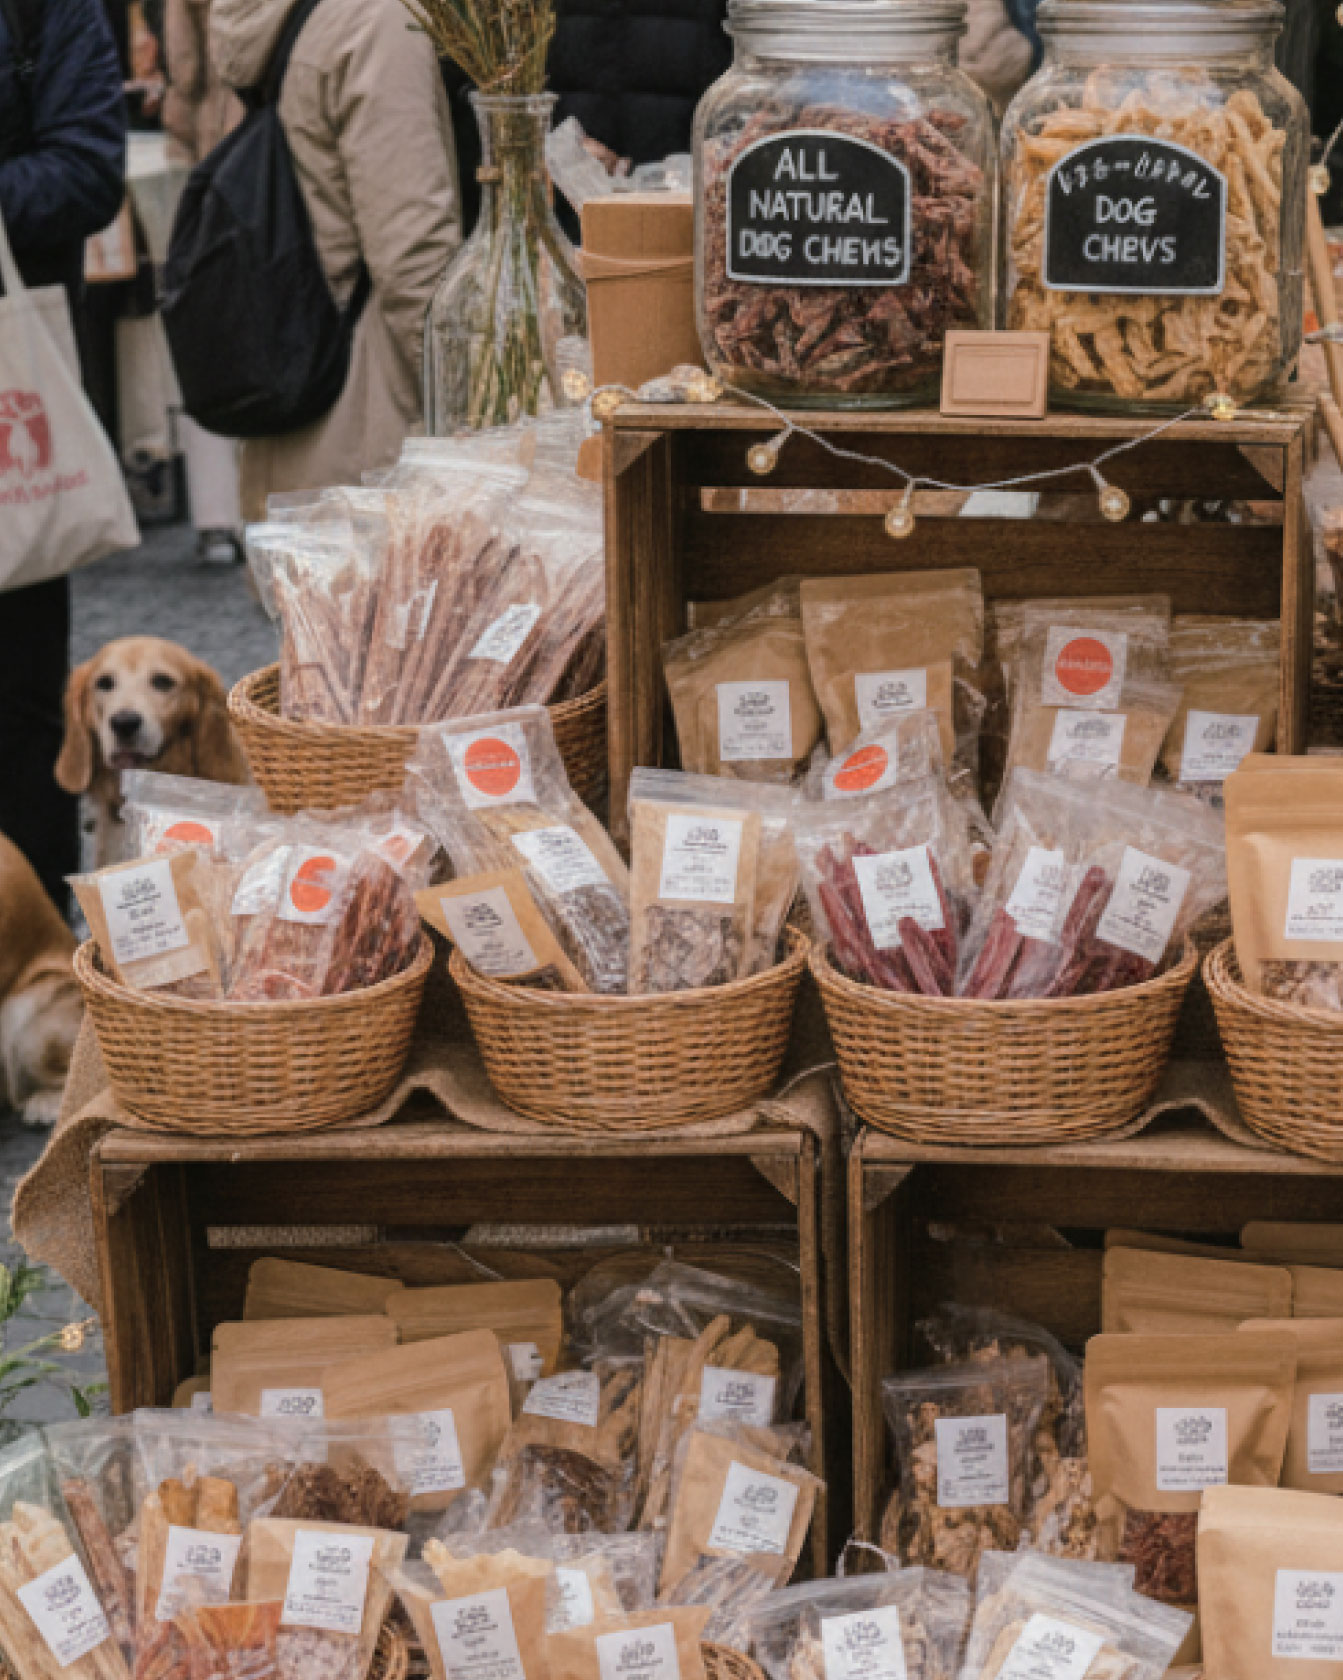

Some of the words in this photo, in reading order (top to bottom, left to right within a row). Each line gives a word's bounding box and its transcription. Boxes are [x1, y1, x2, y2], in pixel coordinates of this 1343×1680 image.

[773, 146, 839, 182] ALL
[749, 188, 889, 224] NATURAL
[1095, 194, 1157, 226] DOG
[738, 228, 793, 263] DOG
